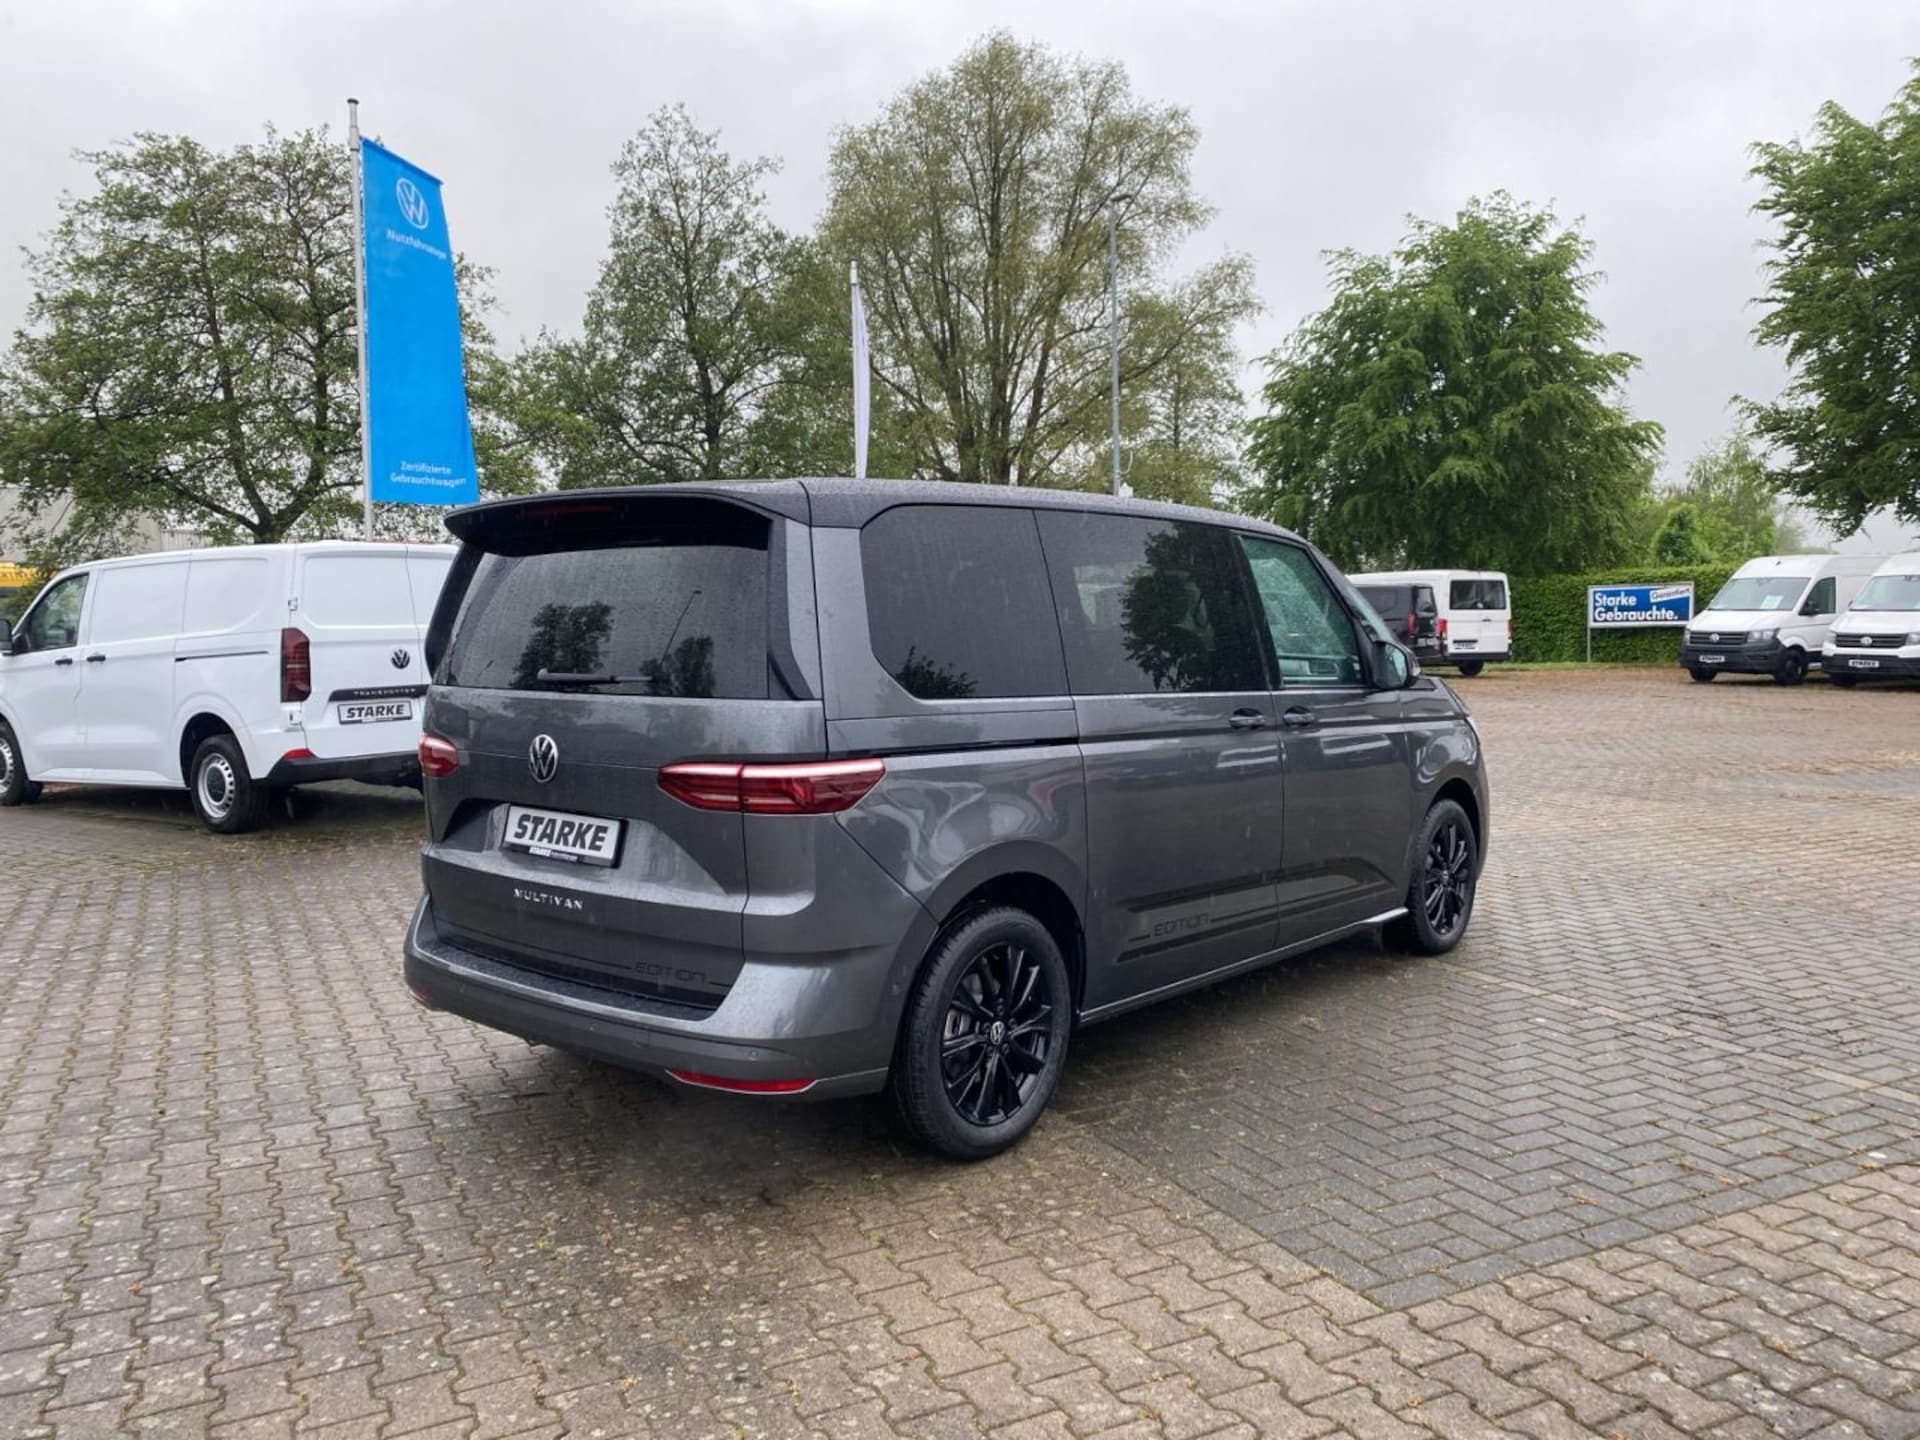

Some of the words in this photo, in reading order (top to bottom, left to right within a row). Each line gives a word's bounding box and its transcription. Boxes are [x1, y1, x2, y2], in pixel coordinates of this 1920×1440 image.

[390, 473, 467, 488] Gebrauchtwagen
[1594, 592, 1637, 607] Starke
[1594, 606, 1678, 621] Gebrauchte.
[346, 704, 404, 719] STARKE
[514, 813, 609, 851] STARKE
[514, 888, 583, 910] MULTIVAN
